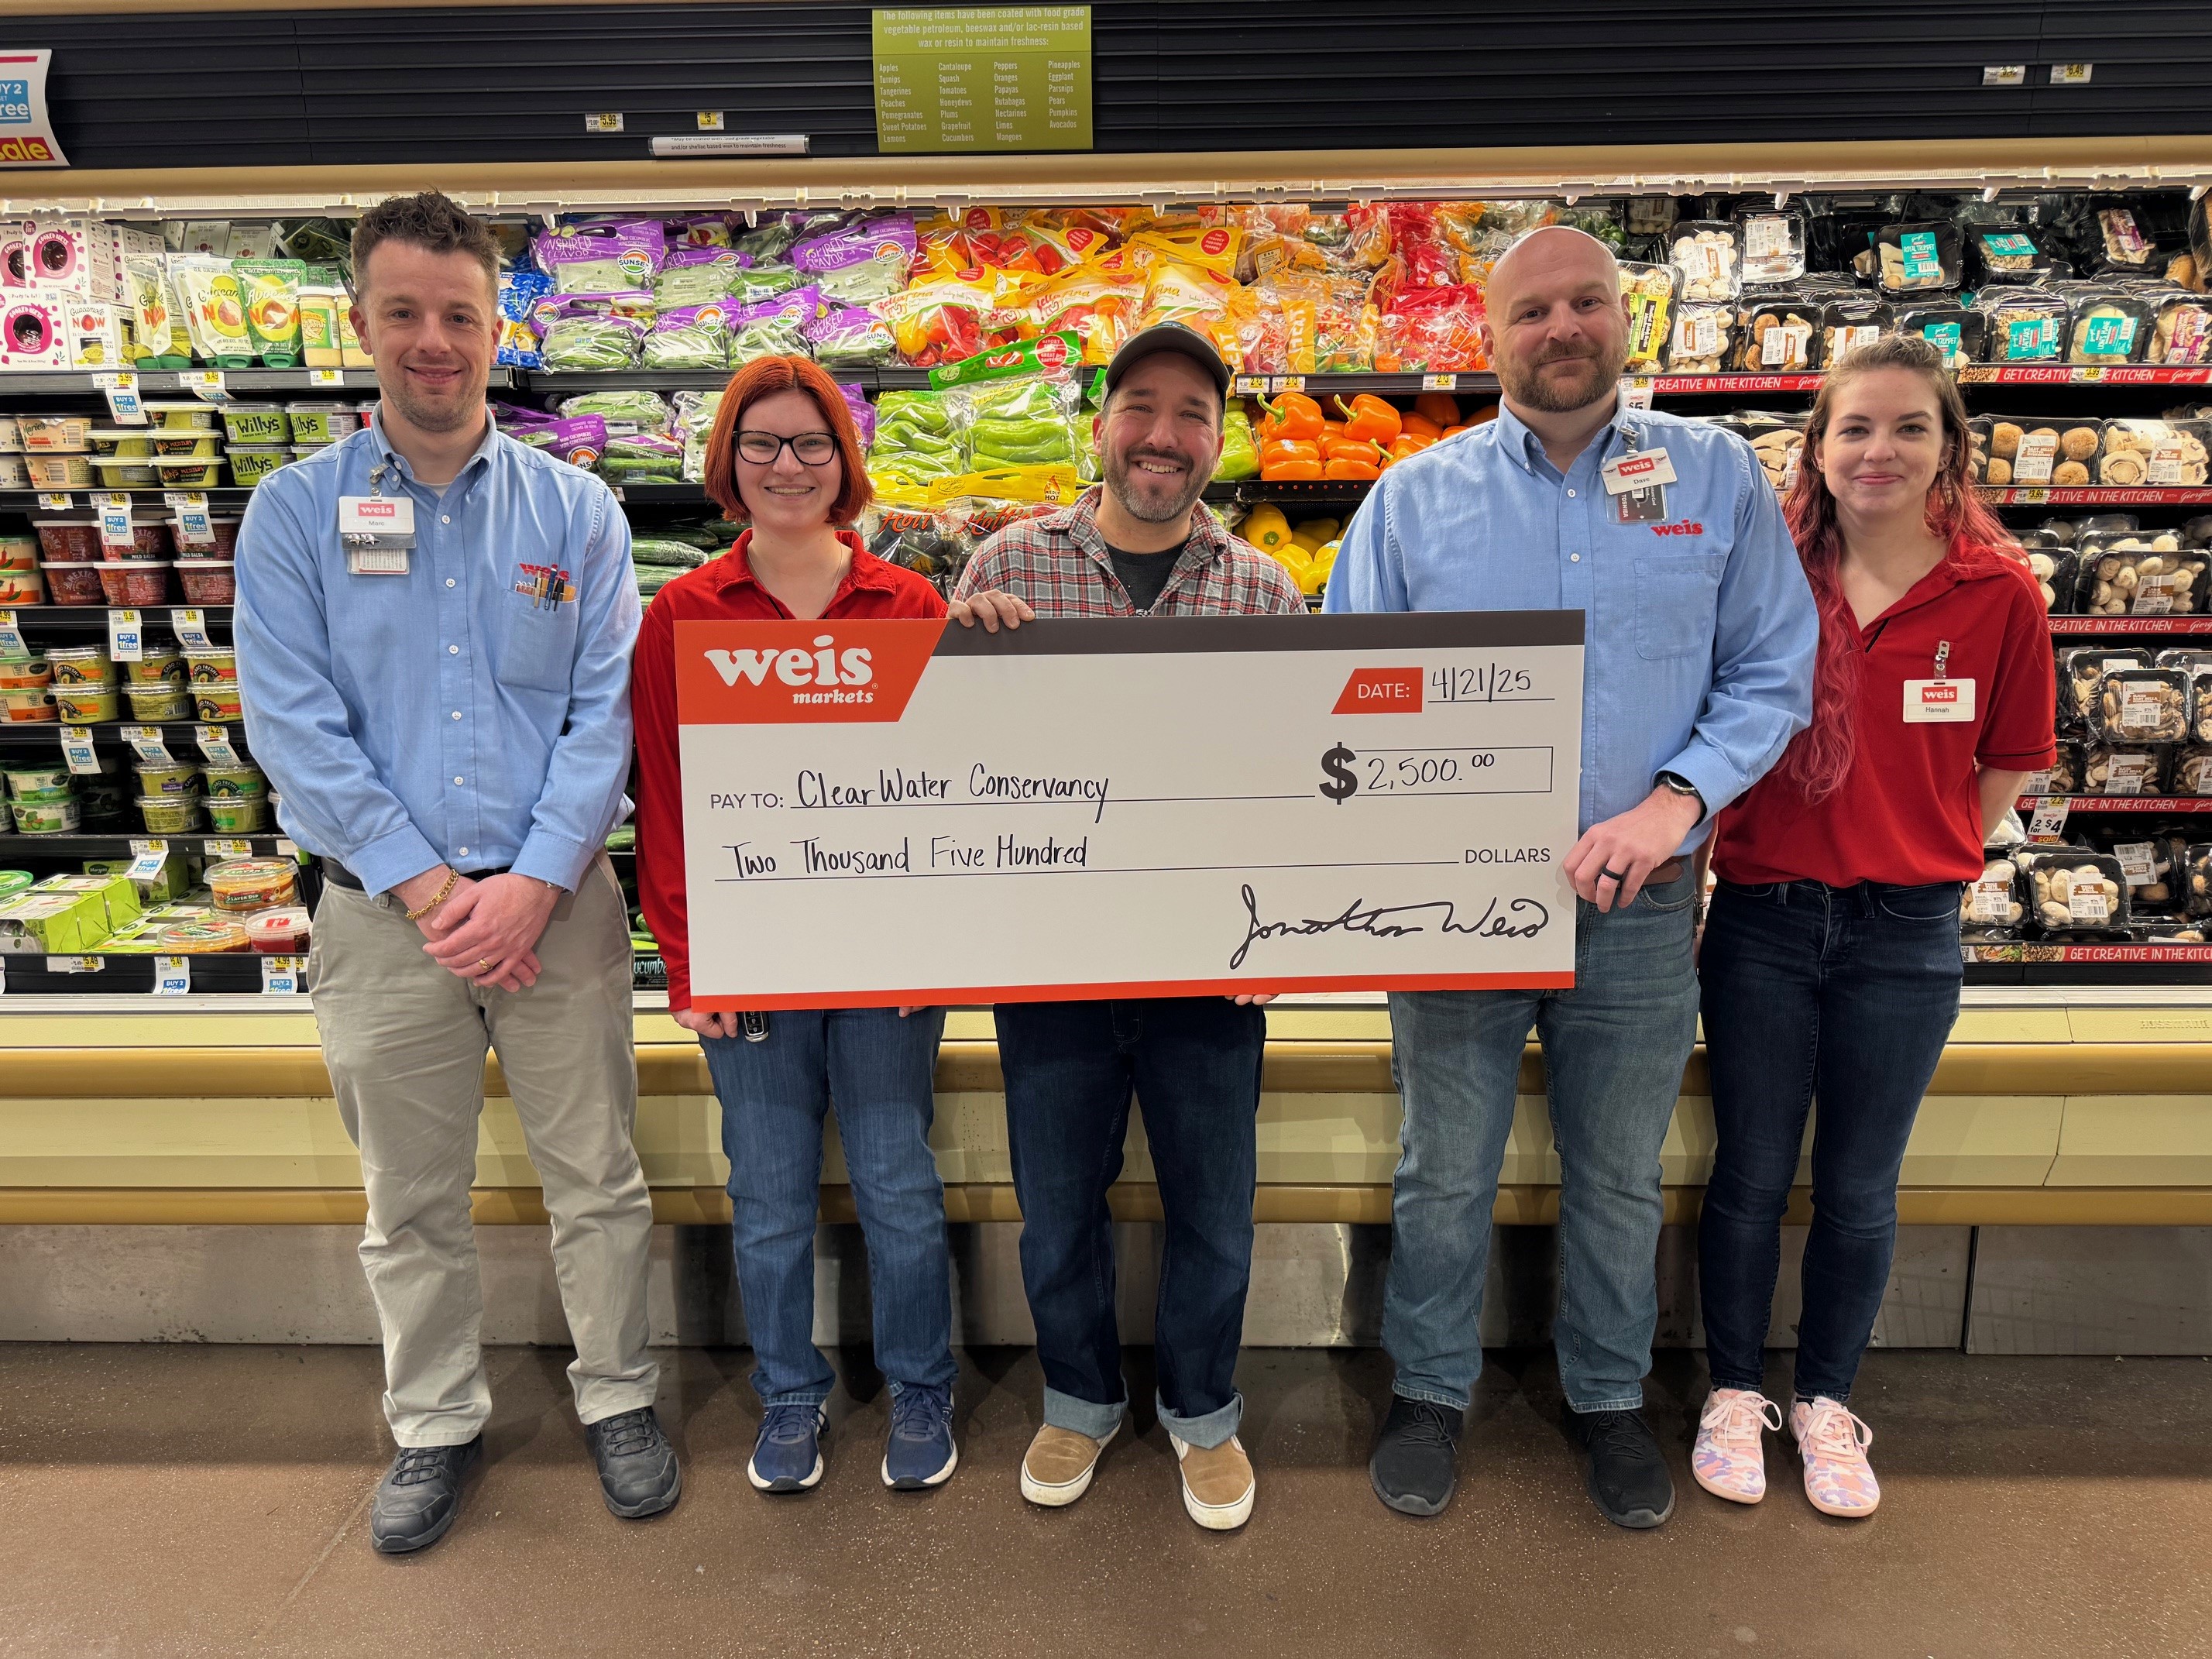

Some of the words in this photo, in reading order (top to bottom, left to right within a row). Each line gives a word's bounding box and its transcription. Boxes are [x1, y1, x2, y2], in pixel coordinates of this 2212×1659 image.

[883, 11, 895, 20] The
[898, 11, 933, 21] following
[935, 10, 955, 19] items
[957, 9, 974, 19] have
[977, 9, 995, 19] been
[998, 9, 1023, 18] coated
[1025, 8, 1042, 17] with
[1044, 8, 1060, 16] food
[1063, 7, 1084, 19] grade
[884, 25, 920, 36] vegetable
[922, 24, 963, 34] petroleum,
[966, 23, 997, 33] beeswax
[999, 22, 1024, 32] and/or
[1026, 22, 1058, 31] lac-resin
[1061, 21, 1083, 30] based
[945, 37, 963, 47] resin
[966, 38, 973, 46] to
[976, 36, 1008, 46] maintain
[1011, 36, 1049, 46] freshness:
[879, 64, 898, 73] Apples
[939, 62, 972, 72] Cantaloupe
[994, 61, 1018, 70] Peppers
[1048, 60, 1080, 70] Pineapples
[879, 75, 901, 84] Turnips
[939, 74, 960, 84] Squash
[994, 73, 1018, 83] Oranges
[1048, 72, 1073, 81] Eggplant
[14, 84, 22, 94] 2
[880, 87, 912, 97] Tangerines
[939, 86, 967, 94] Tomatoes
[994, 85, 1018, 94] Papayas
[1049, 84, 1073, 94] Parsnips
[881, 99, 905, 108] Peaches
[939, 98, 972, 107] Honeydews
[994, 97, 1025, 106] Rutabagas
[1049, 97, 1065, 105] Pears
[881, 111, 923, 120] Pomegranates
[940, 110, 958, 118] Plums
[995, 109, 1027, 118] Nectarines
[1049, 108, 1077, 118] Pumpkins
[599, 114, 617, 125] $5.99
[1049, 120, 1077, 129] Avocados
[882, 122, 900, 132] Sweet
[901, 122, 927, 131] Potatoes
[941, 122, 971, 131] Grapefruit
[996, 121, 1013, 129] Limes
[884, 134, 905, 143] Lemons
[942, 133, 974, 143] Cucumbers
[996, 132, 1022, 142] Mangoes
[70, 307, 105, 316] Guacamole
[1938, 336, 1957, 345] TRUMPET
[2021, 327, 2031, 352] MAITAKE
[2003, 369, 2023, 380] GET
[2086, 367, 2100, 376] $3.99
[2111, 369, 2155, 380] KITCHEN
[2171, 368, 2206, 383] Giorgio
[1705, 378, 1717, 389] IN
[1718, 377, 1737, 389] THE
[1738, 376, 1781, 389] KITCHEN
[22, 422, 46, 436] Marie's
[235, 415, 280, 436] Willy's
[234, 454, 274, 475] Willy's
[1620, 461, 1652, 472] weis
[50, 493, 65, 502] $4.49
[110, 493, 126, 502] $4.99
[187, 493, 202, 501] $4.99
[2028, 489, 2044, 498] $3.99
[2087, 491, 2097, 502] IN
[2099, 491, 2119, 502] THE
[2120, 491, 2163, 502] KITCHEN
[359, 504, 393, 514] weis
[1650, 520, 1703, 537] weis
[2095, 620, 2107, 631] IN
[2108, 620, 2128, 631] THE
[2128, 620, 2172, 631] KITCHEN
[704, 634, 873, 687] weis
[1431, 663, 1531, 702] 4/21/25
[1357, 683, 1410, 699] DATE:
[1924, 689, 1955, 699] weis
[792, 689, 874, 704] markets
[73, 727, 87, 736] $5.99
[1319, 741, 1358, 805] $
[969, 762, 1109, 824] Conservancy
[710, 794, 746, 809] PAY
[749, 792, 785, 808] TO:
[2099, 799, 2111, 809] IN
[2112, 799, 2131, 809] THE
[2132, 799, 2177, 809] KITCHEN
[2045, 819, 2063, 833] $4
[232, 840, 246, 848] $5.99
[722, 841, 776, 879] Two
[790, 836, 910, 874] Thousand
[931, 835, 985, 867] Five
[996, 833, 1087, 867] Hundred
[1465, 848, 1551, 864] DOLLARS
[2070, 947, 2092, 960] GET
[2093, 947, 2147, 960] CREATIVE
[2151, 947, 2162, 960] IN
[2164, 947, 2184, 960] THE
[170, 957, 183, 966] $5.49
[275, 957, 290, 965] $4.99
